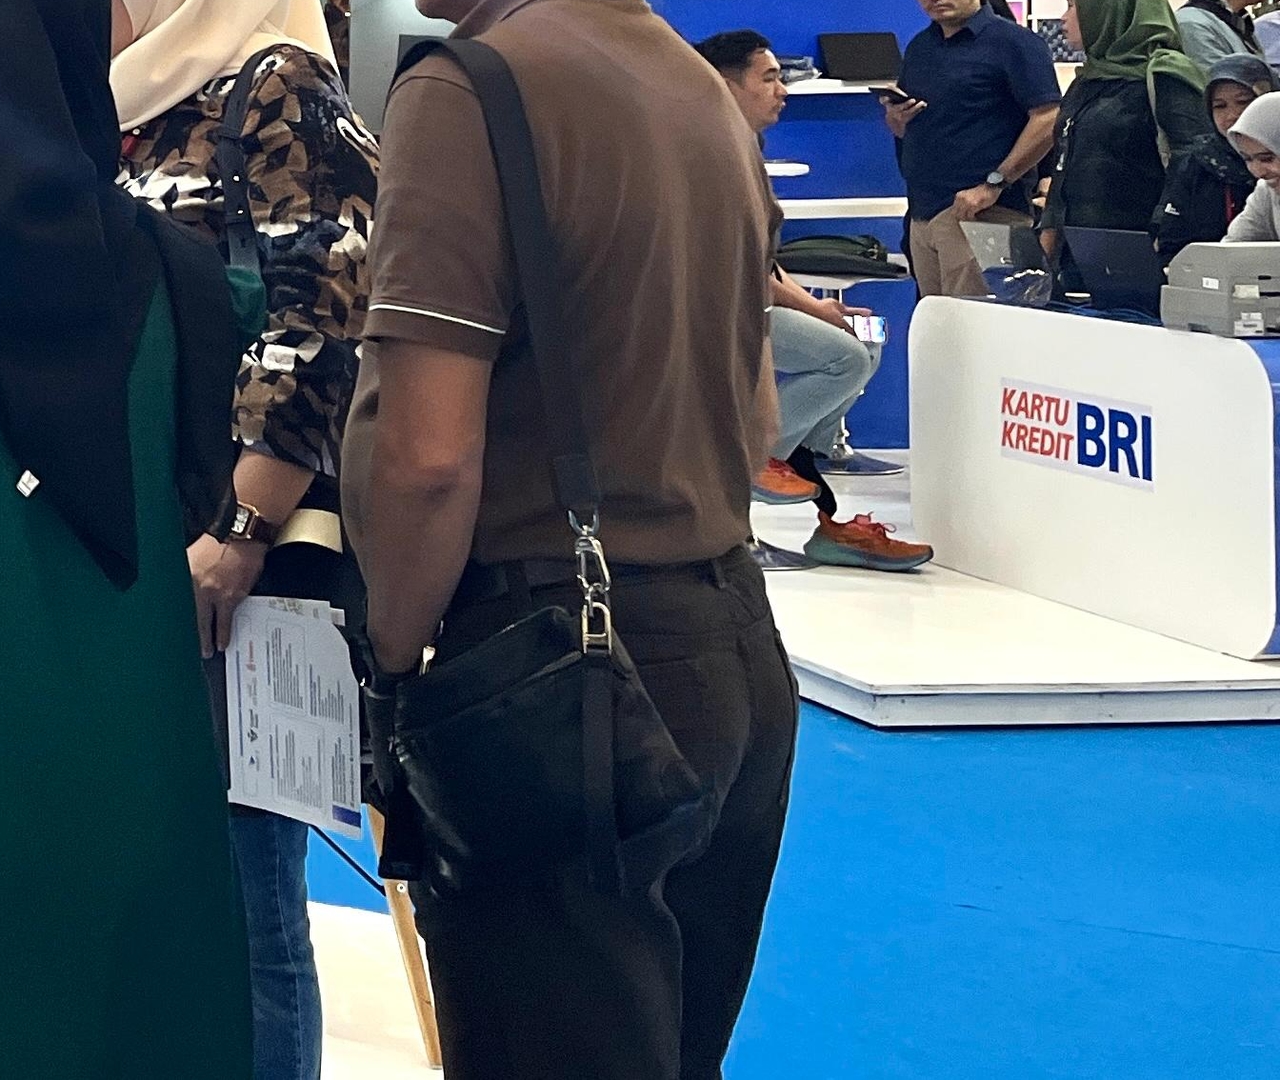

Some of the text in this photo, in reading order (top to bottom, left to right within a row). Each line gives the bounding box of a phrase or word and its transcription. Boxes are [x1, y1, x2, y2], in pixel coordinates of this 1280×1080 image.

[1001, 387, 1070, 426] KARTU
[1001, 421, 1074, 461] KREDIT
[1076, 402, 1153, 482] BRI
